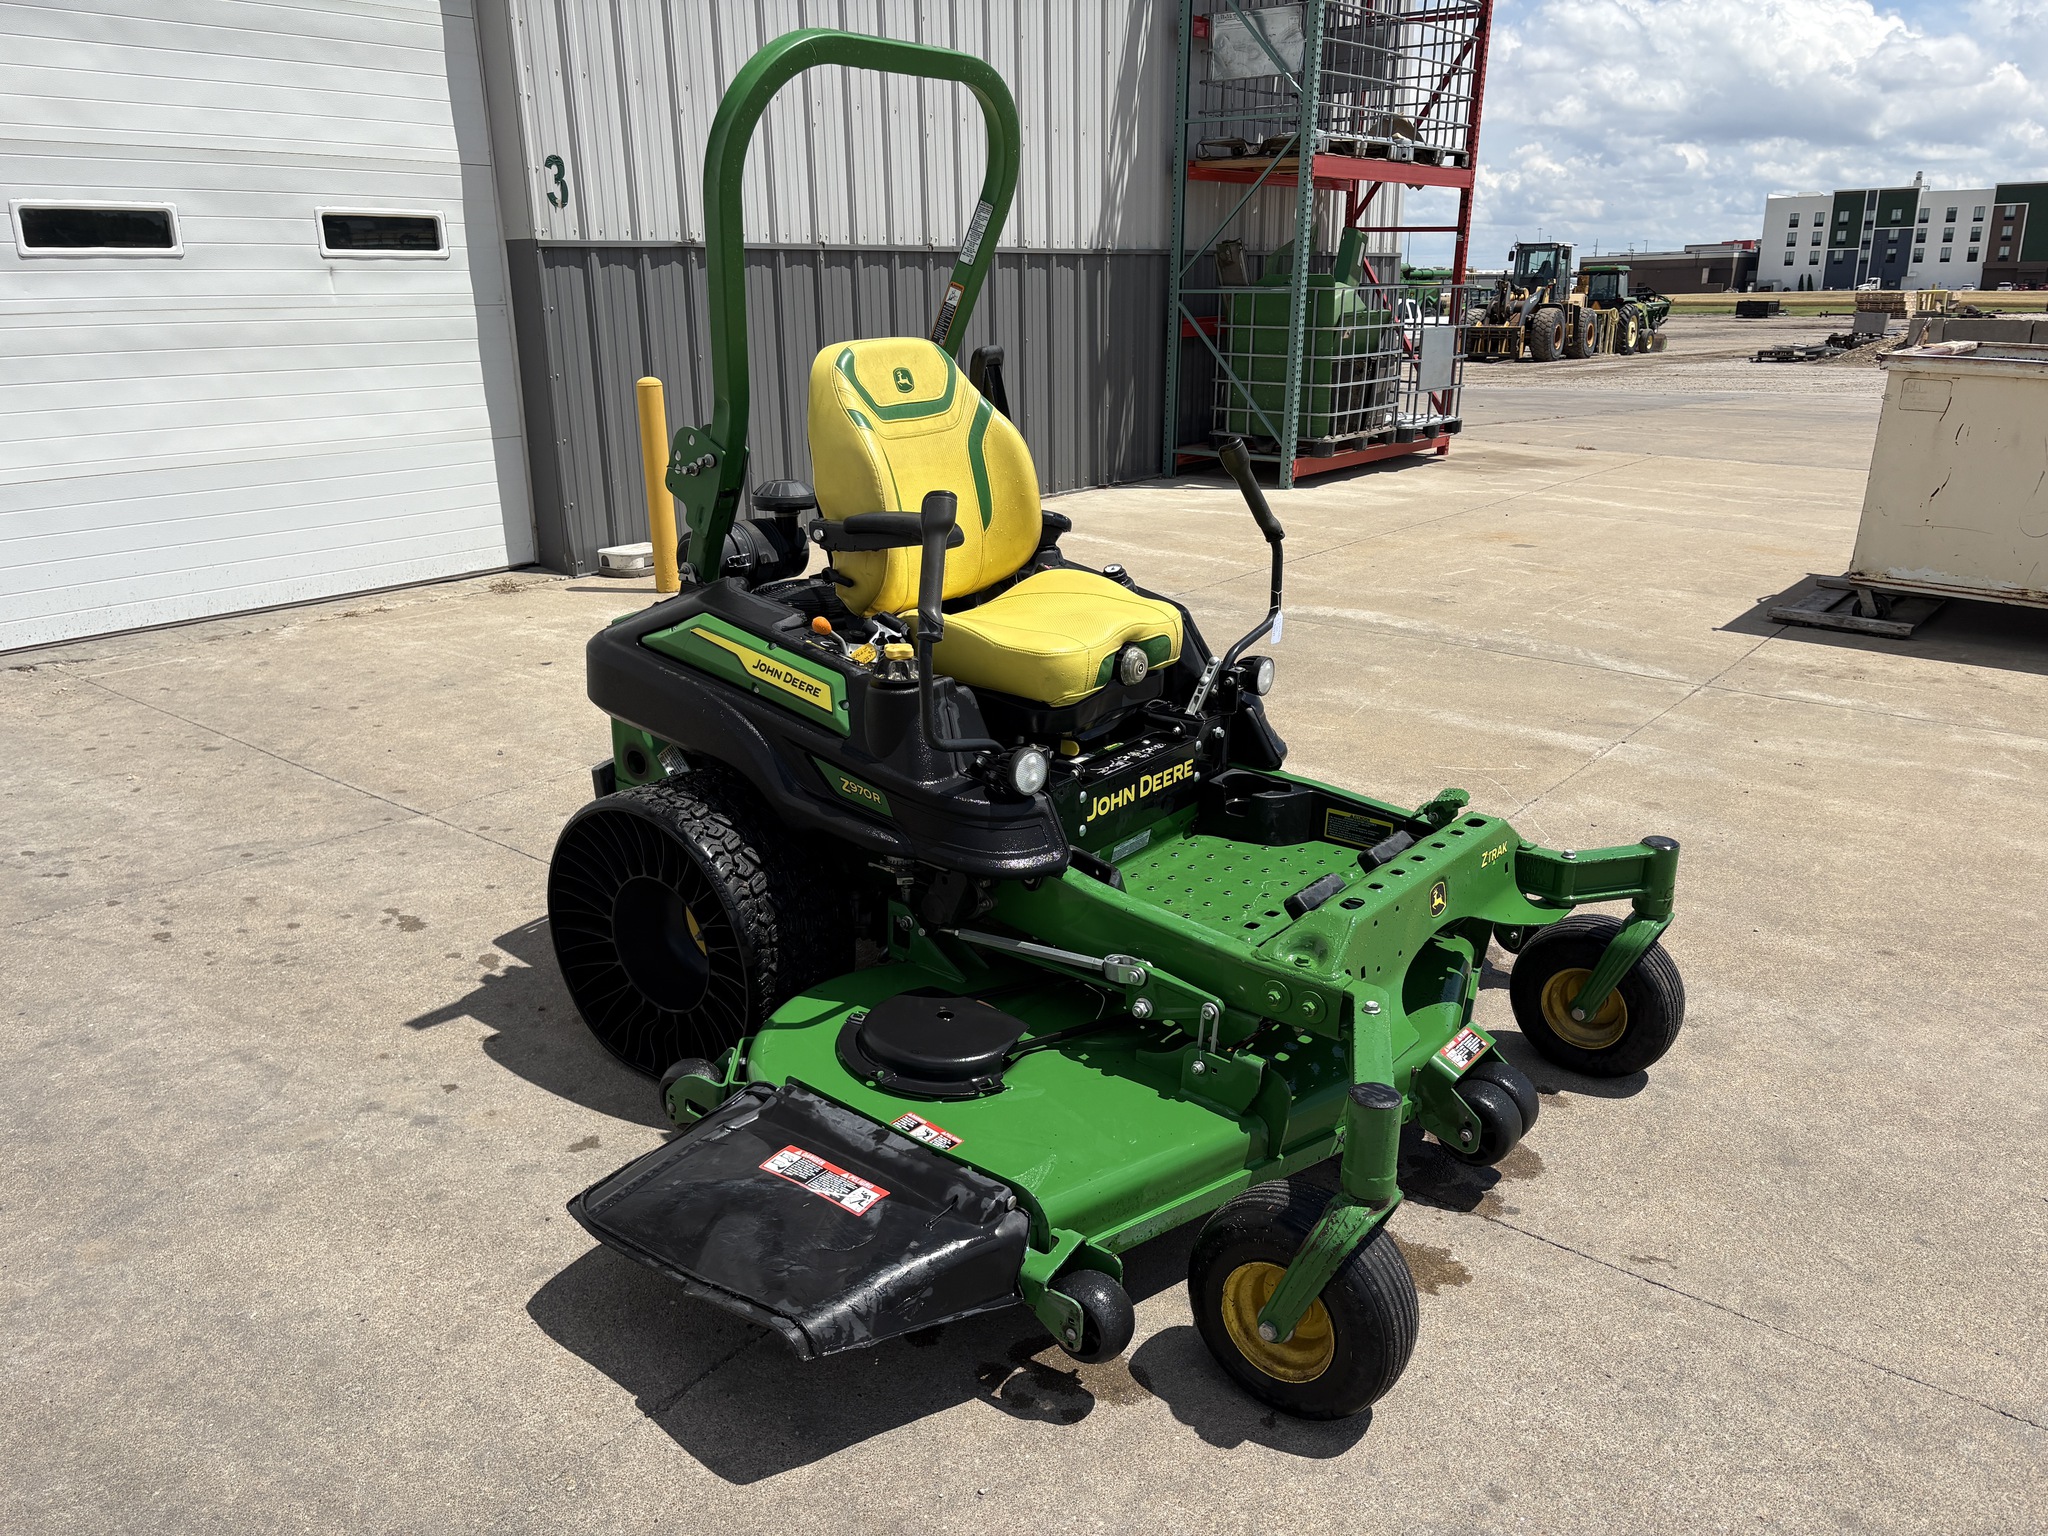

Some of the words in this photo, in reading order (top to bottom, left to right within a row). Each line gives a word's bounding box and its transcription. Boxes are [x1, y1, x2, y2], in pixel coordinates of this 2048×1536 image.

[544, 154, 569, 210] 3
[752, 659, 783, 681] JOHN
[783, 672, 822, 698] DEERE
[840, 776, 881, 805] Z970R
[1086, 784, 1136, 822] JOHN
[1139, 759, 1194, 799] DEERE
[801, 1151, 826, 1166] DANGER
[848, 1173, 875, 1190] PELIGRO
